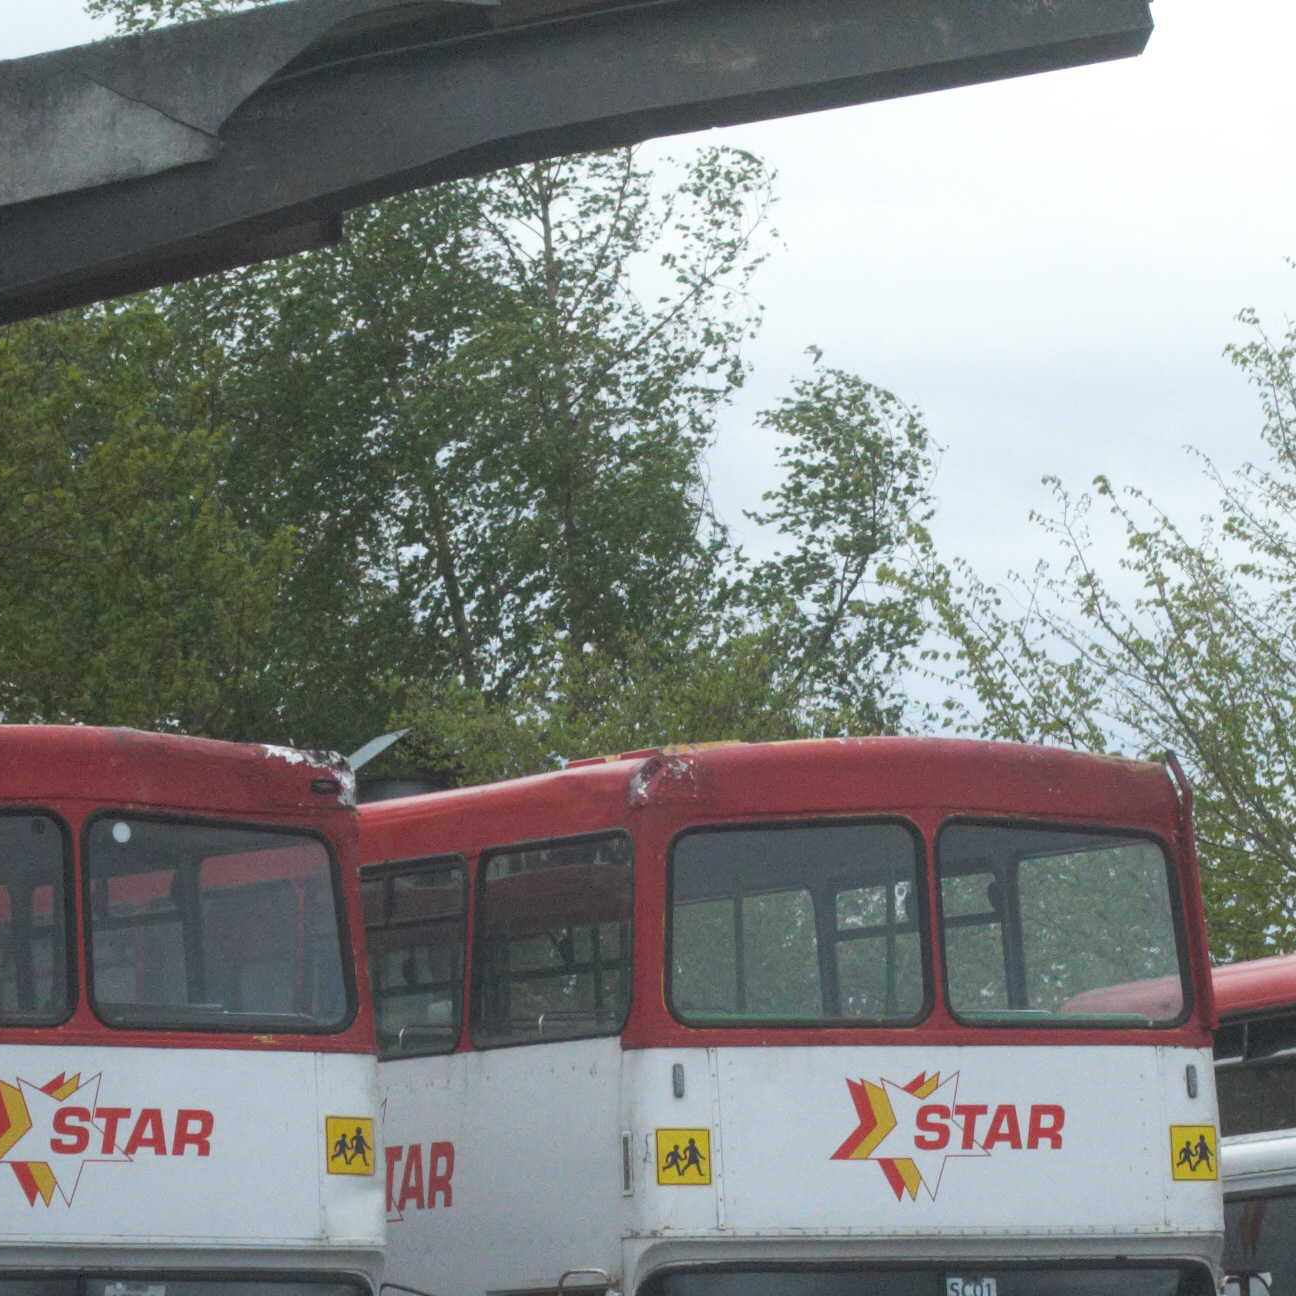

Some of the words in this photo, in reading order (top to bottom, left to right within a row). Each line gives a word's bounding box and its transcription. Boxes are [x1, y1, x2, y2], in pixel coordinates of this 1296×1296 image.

[50, 1106, 214, 1157] STAR
[913, 1103, 1065, 1150] STAR
[384, 1141, 455, 1212] TAR
